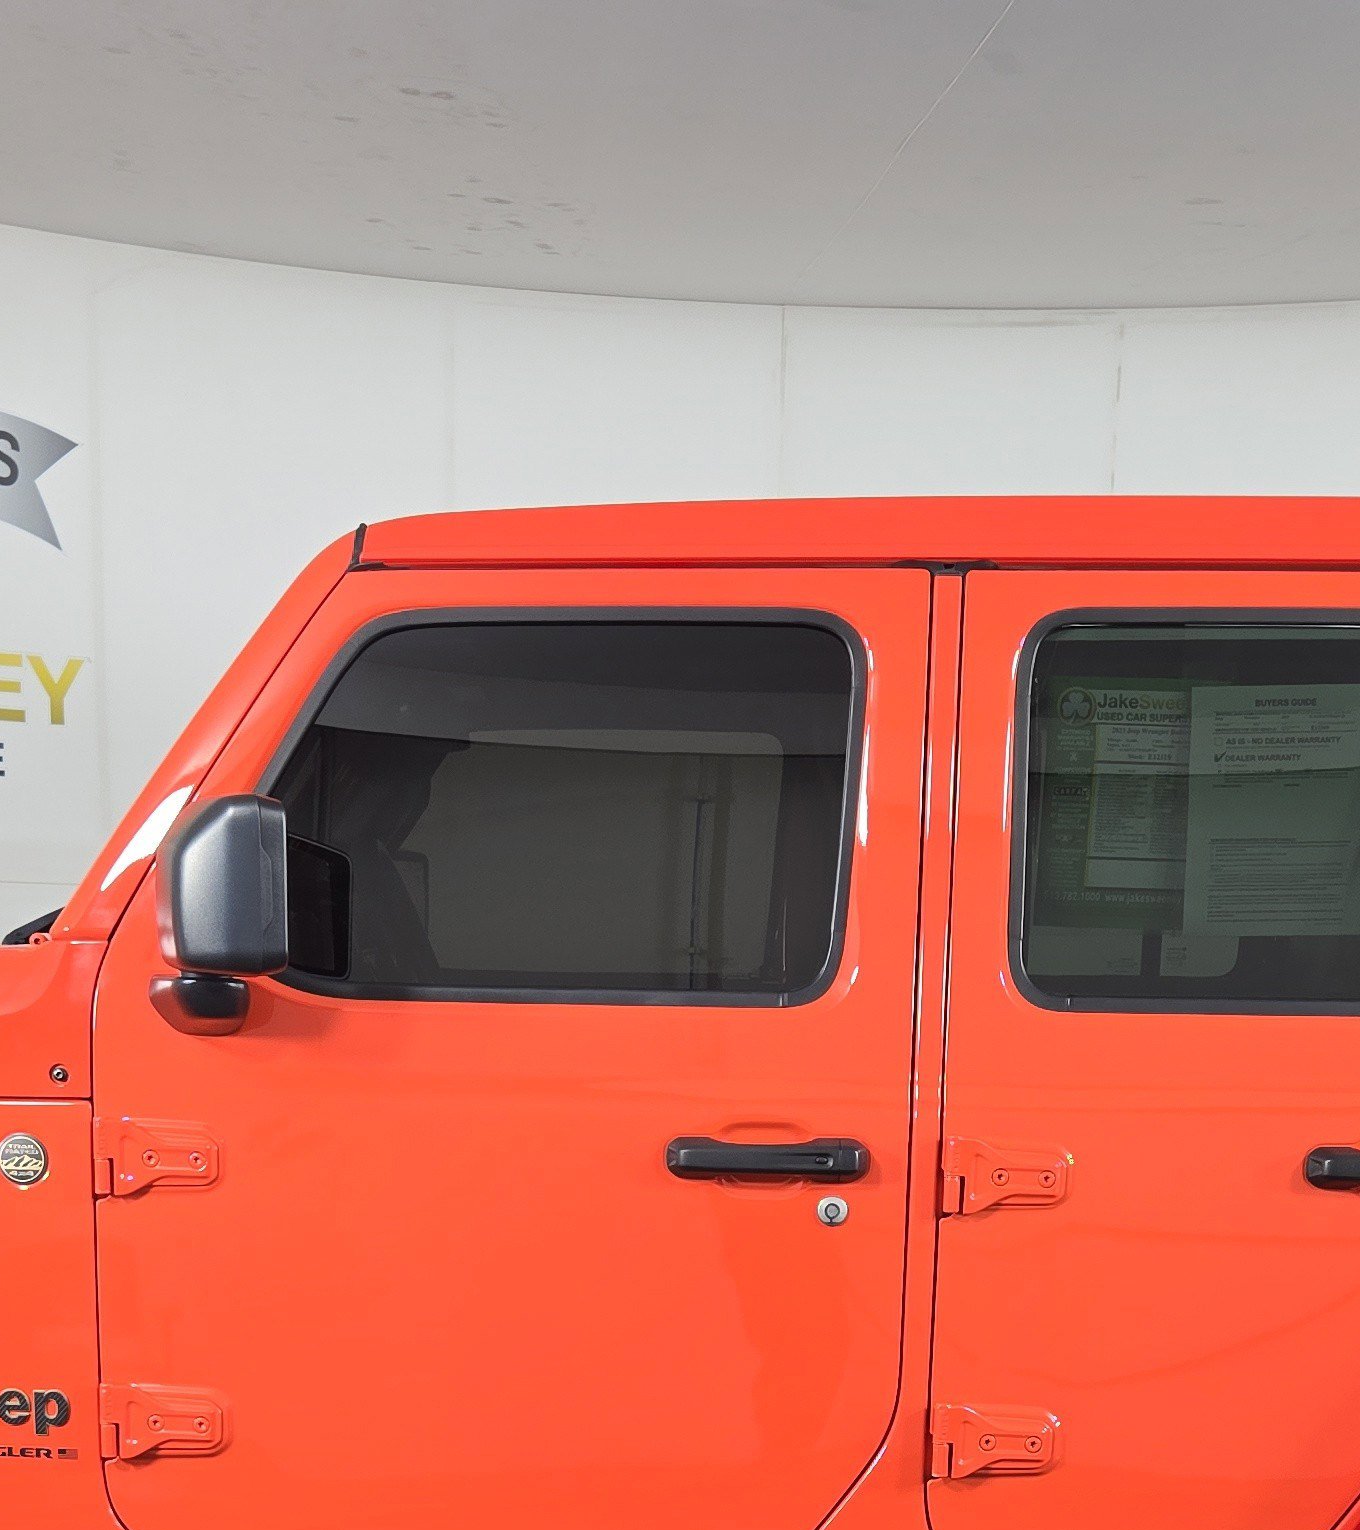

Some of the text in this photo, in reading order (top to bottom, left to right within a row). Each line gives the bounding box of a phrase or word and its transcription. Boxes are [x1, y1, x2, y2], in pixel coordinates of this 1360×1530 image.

[1255, 698, 1317, 707] BUYERS GUIDE
[1097, 712, 1123, 721] USED
[1126, 713, 1147, 722] CAR
[1297, 736, 1341, 744] WARRANTY
[1225, 754, 1256, 762] DEALER
